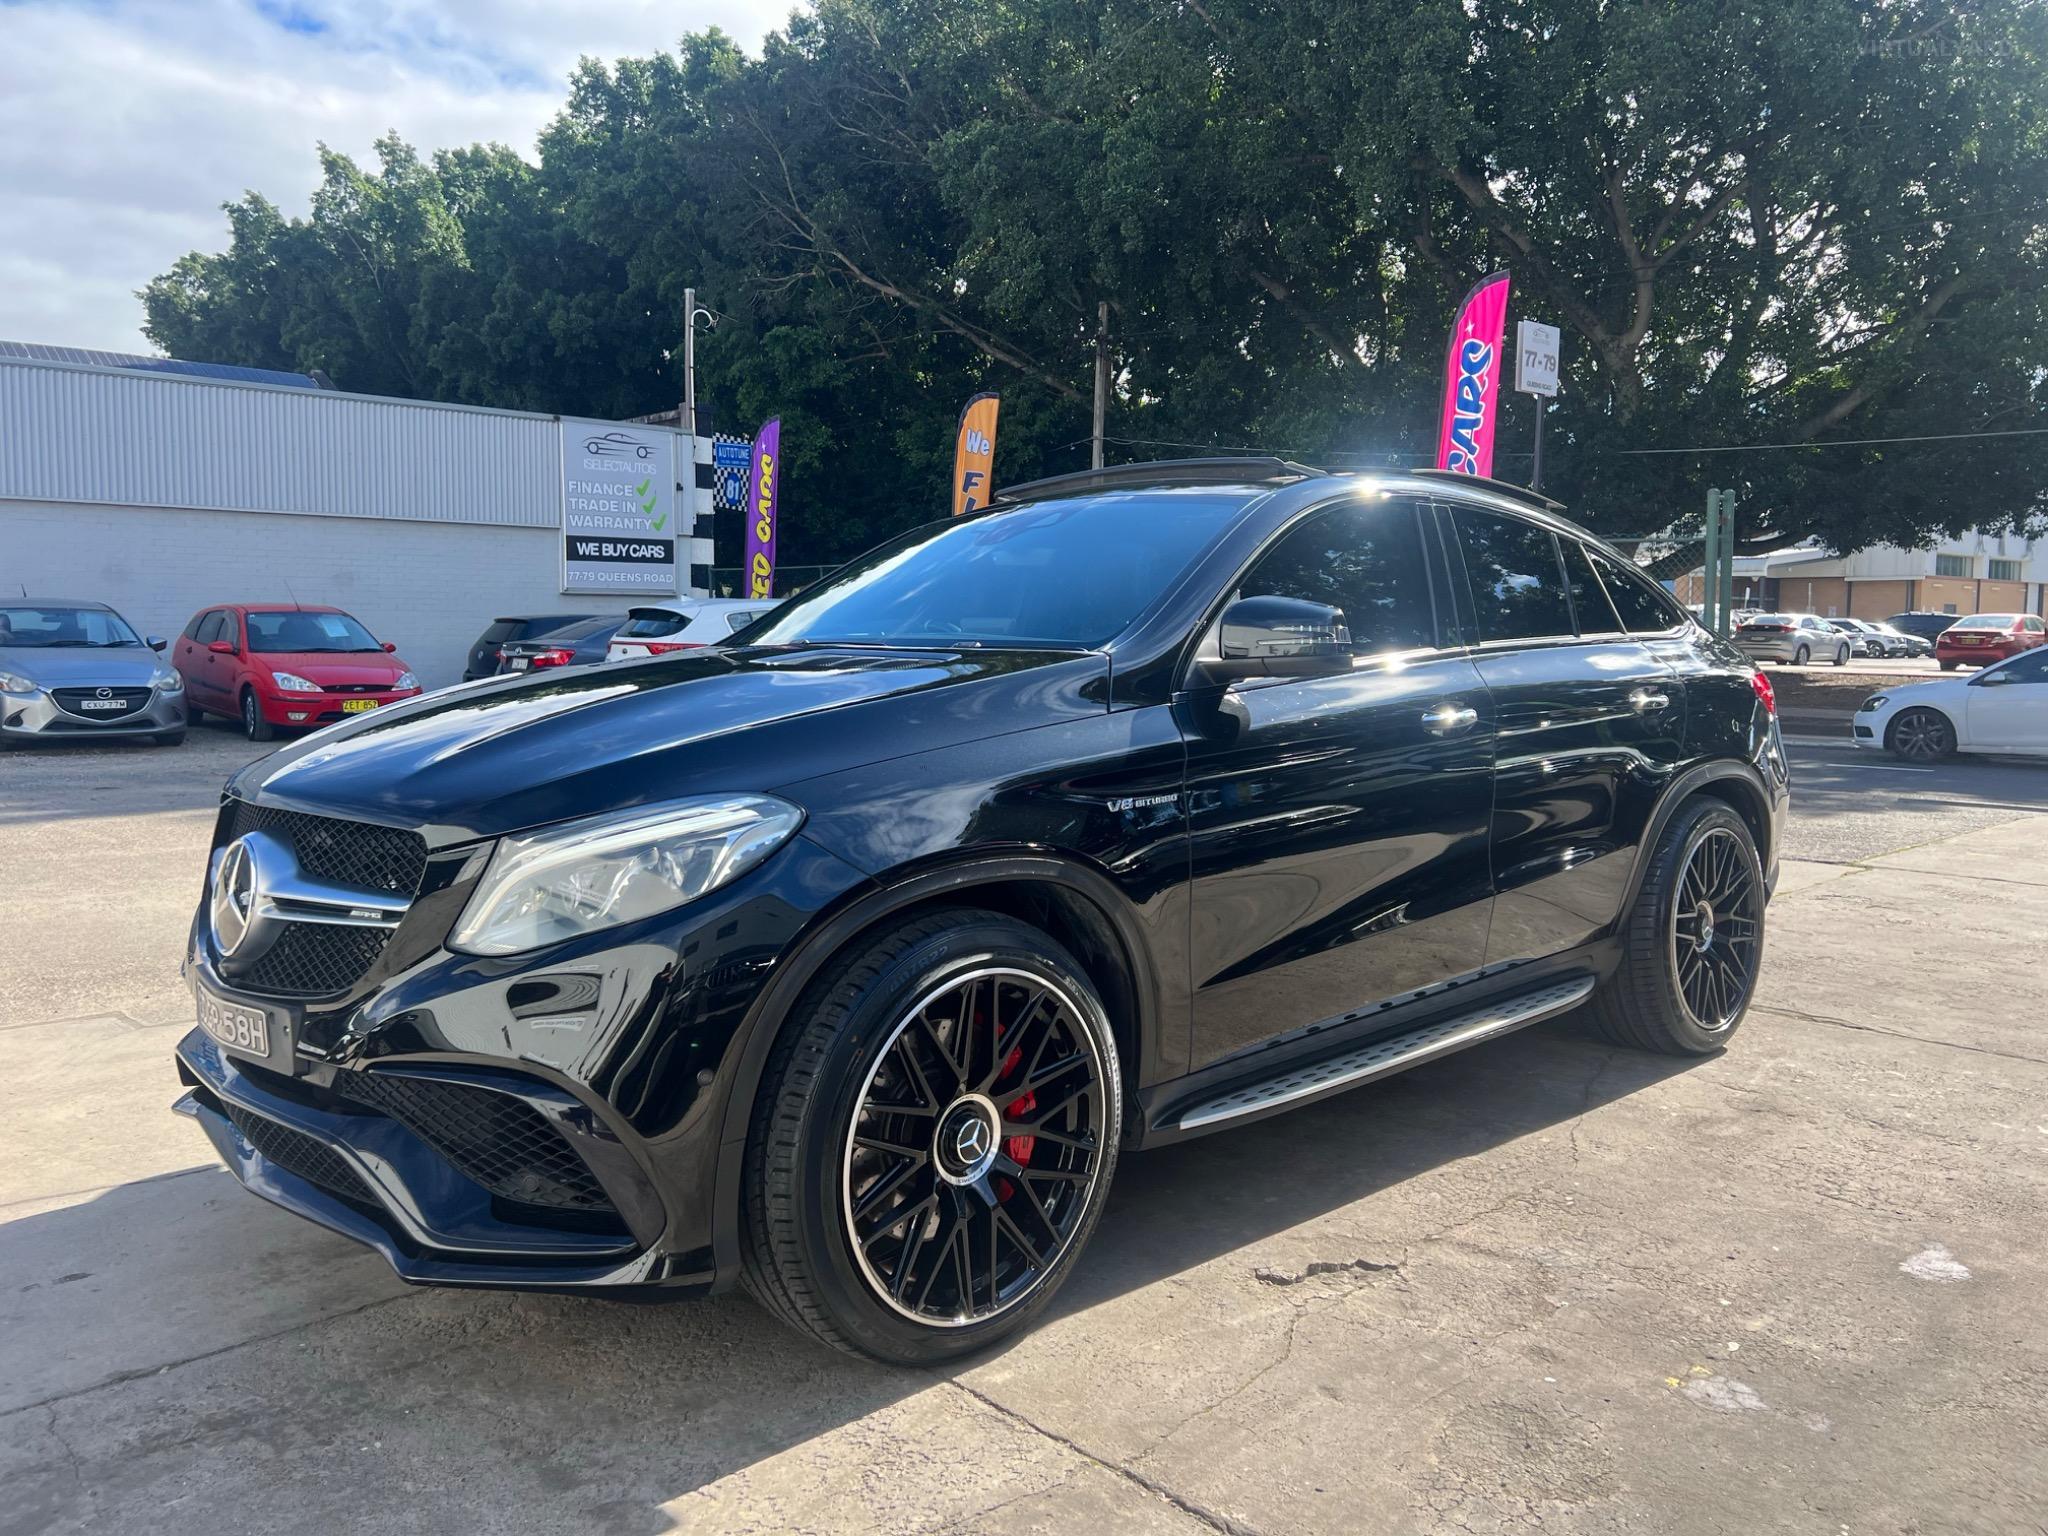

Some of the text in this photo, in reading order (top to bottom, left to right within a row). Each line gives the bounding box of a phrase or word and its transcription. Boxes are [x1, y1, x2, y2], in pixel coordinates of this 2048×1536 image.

[966, 428, 990, 456] We
[583, 459, 657, 474] ISELECTAUTOS
[568, 480, 633, 497] FINANCE
[726, 479, 740, 501] 81
[569, 498, 637, 513] TRADE IN
[569, 515, 651, 530] WARRANTY
[576, 542, 665, 558] WE BUY CARS
[568, 571, 674, 583] 77-79 QUEENS ROAD
[1107, 793, 1178, 812] V8 BITURBO
